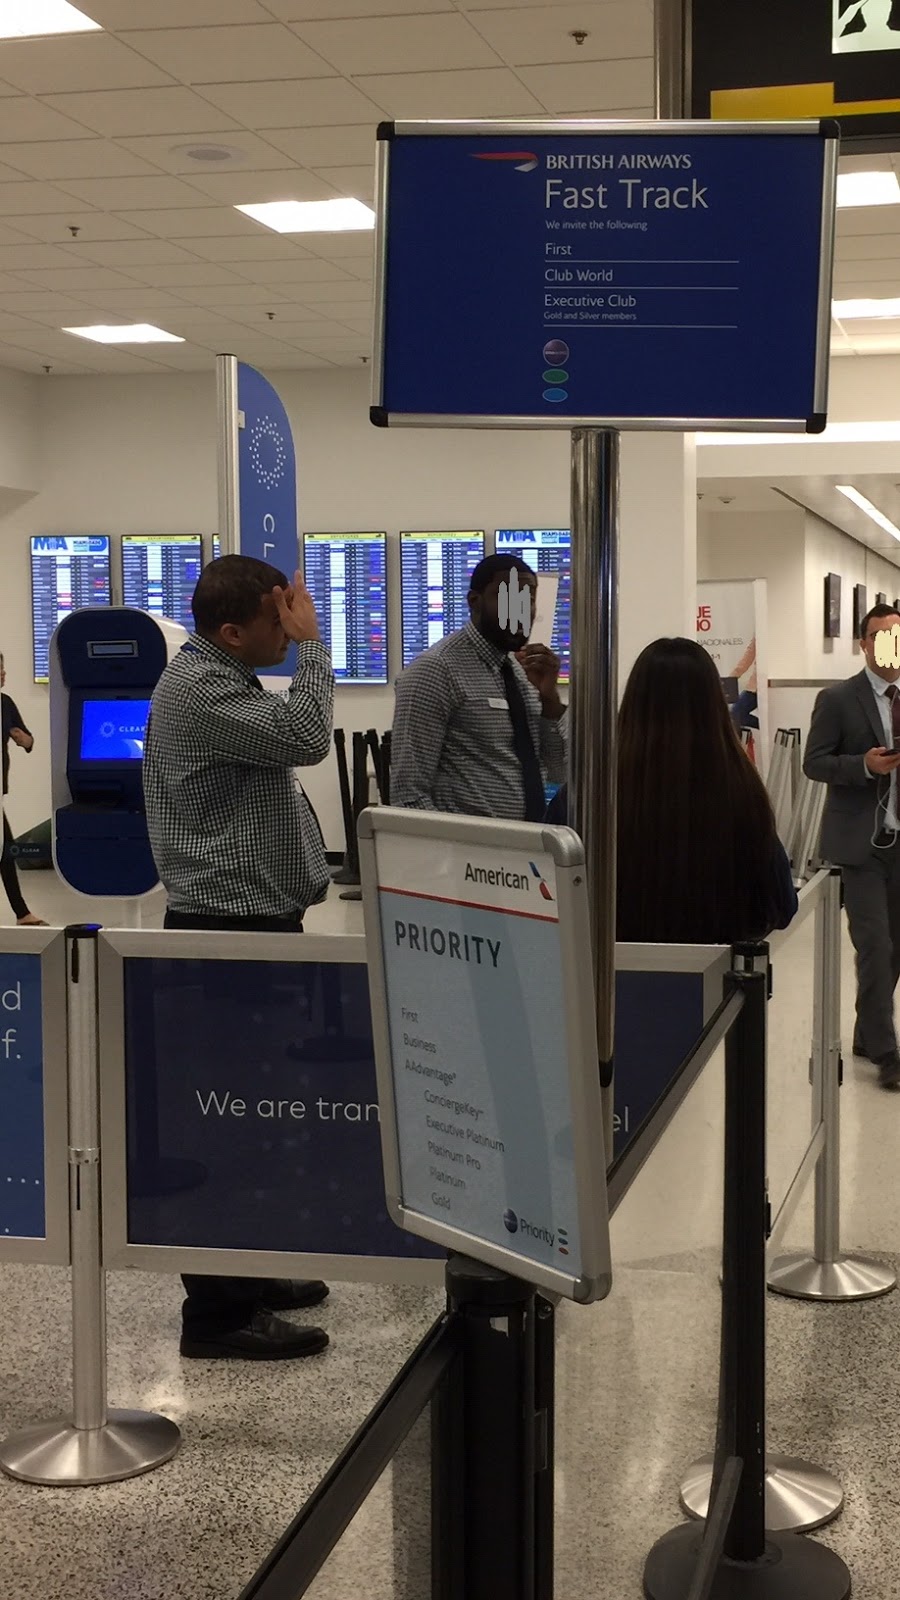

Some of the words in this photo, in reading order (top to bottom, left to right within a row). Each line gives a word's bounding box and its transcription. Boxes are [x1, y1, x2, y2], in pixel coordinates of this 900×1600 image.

[546, 154, 614, 170] BRITISH
[617, 154, 692, 170] AIRWAYS
[545, 178, 608, 209] Fast
[618, 177, 709, 209] Track
[545, 220, 560, 230] We
[562, 219, 587, 230] invite
[588, 219, 605, 230] the
[606, 219, 648, 232] following
[545, 242, 572, 256] First
[544, 268, 574, 282] Club
[576, 269, 614, 282] World
[544, 293, 605, 307] Executive
[607, 294, 637, 308] Club
[543, 311, 563, 320] Gold
[563, 311, 578, 320] and
[579, 312, 600, 321] Silver
[601, 312, 637, 321] members
[263, 513, 276, 558] CL
[465, 862, 530, 891] American
[394, 920, 501, 968] PRIORITY
[2, 981, 20, 1010] d
[401, 1007, 419, 1023] First
[1, 1028, 21, 1059] f.
[403, 1033, 437, 1054] Business
[195, 1089, 246, 1117] We
[257, 1099, 306, 1119] are
[316, 1097, 381, 1122] tran
[613, 1106, 629, 1132] el
[426, 1115, 465, 1139] Executive
[466, 1128, 505, 1152] Platinum
[427, 1141, 464, 1164] Platinum
[465, 1154, 481, 1170] Pro
[429, 1166, 466, 1189] Platinum
[431, 1192, 451, 1210] Gold
[520, 1218, 555, 1247] Priority
